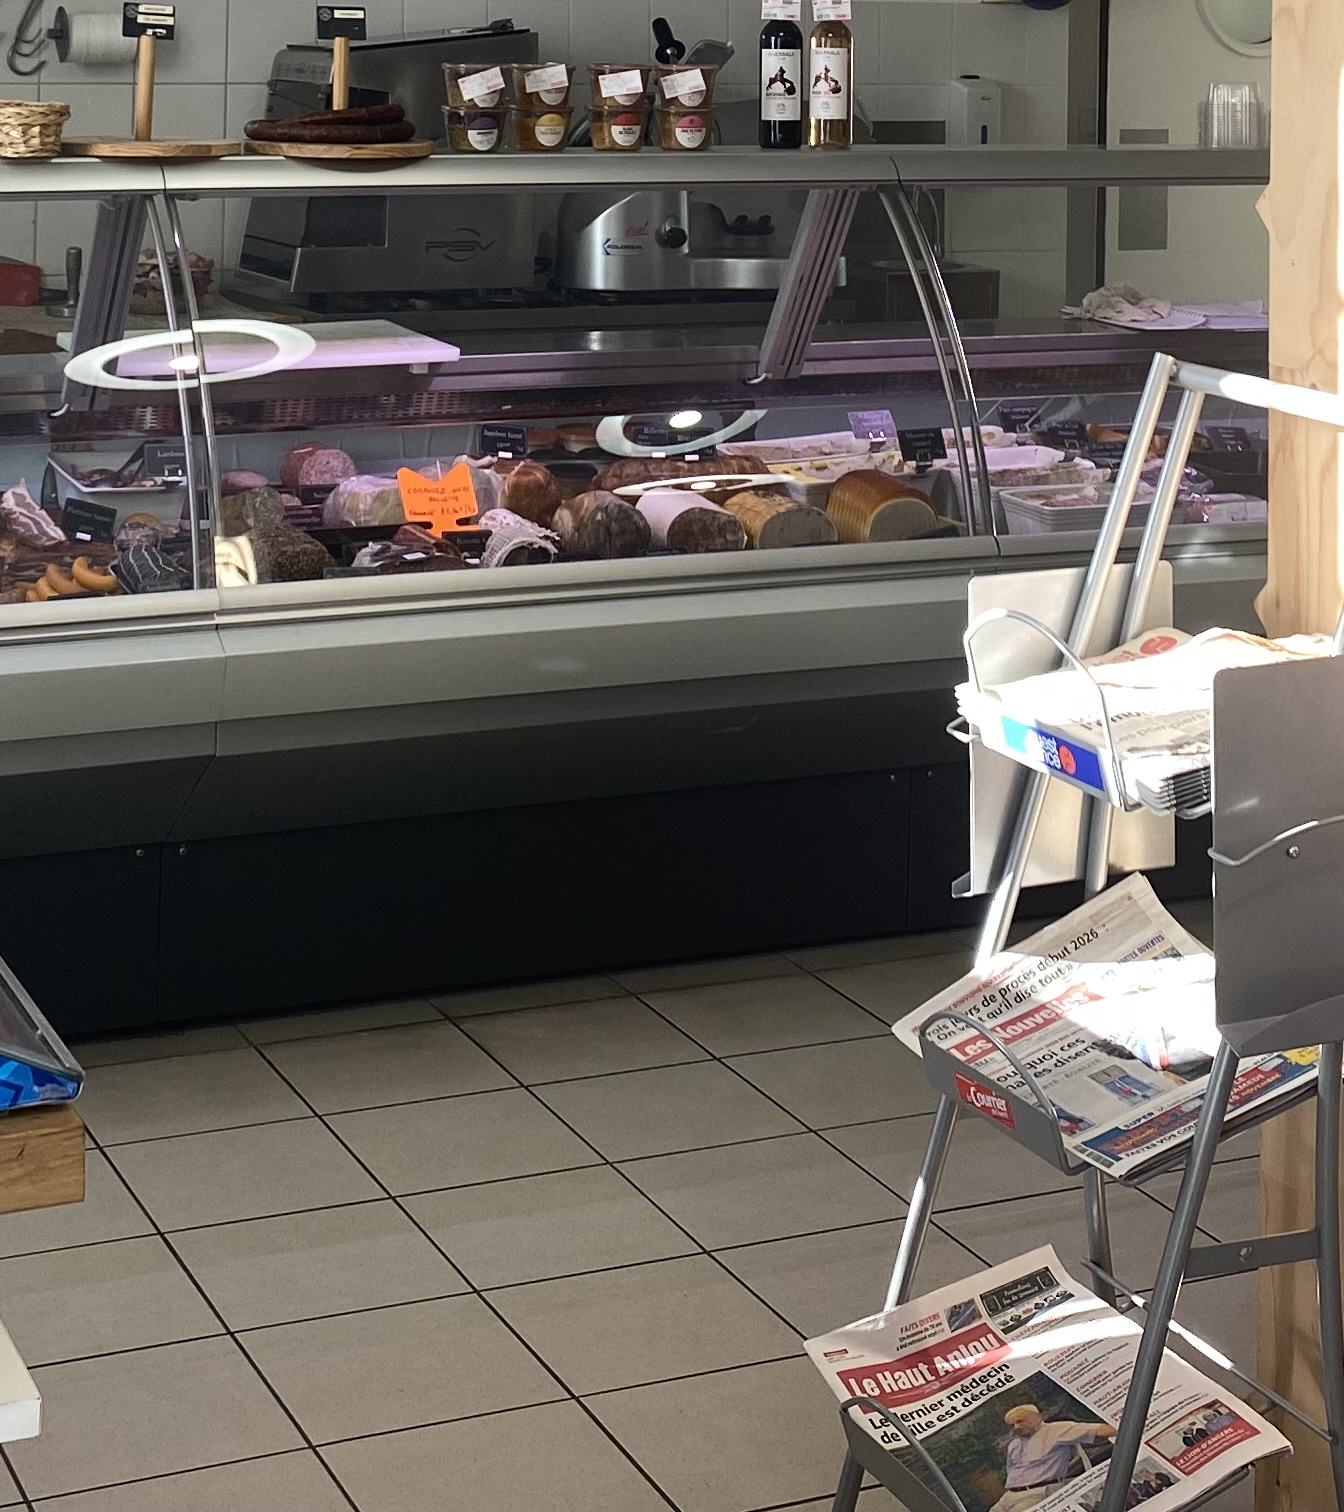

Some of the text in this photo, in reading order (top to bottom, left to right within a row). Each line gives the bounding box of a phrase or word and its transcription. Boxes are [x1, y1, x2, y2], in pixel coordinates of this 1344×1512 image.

[980, 992, 998, 1010] de
[1070, 928, 1099, 952] 2026
[1014, 984, 1038, 1006] dise
[948, 1036, 993, 1063] Les
[1054, 1041, 1105, 1072] disent
[1058, 1038, 1086, 1056] ces
[1123, 1110, 1154, 1129] SUPER
[848, 1377, 878, 1397] Le
[879, 1359, 936, 1393] Haut
[935, 1333, 1001, 1377] Anjou
[869, 1362, 1011, 1430] Le médecin
[880, 1372, 1016, 1445] de est décédé
